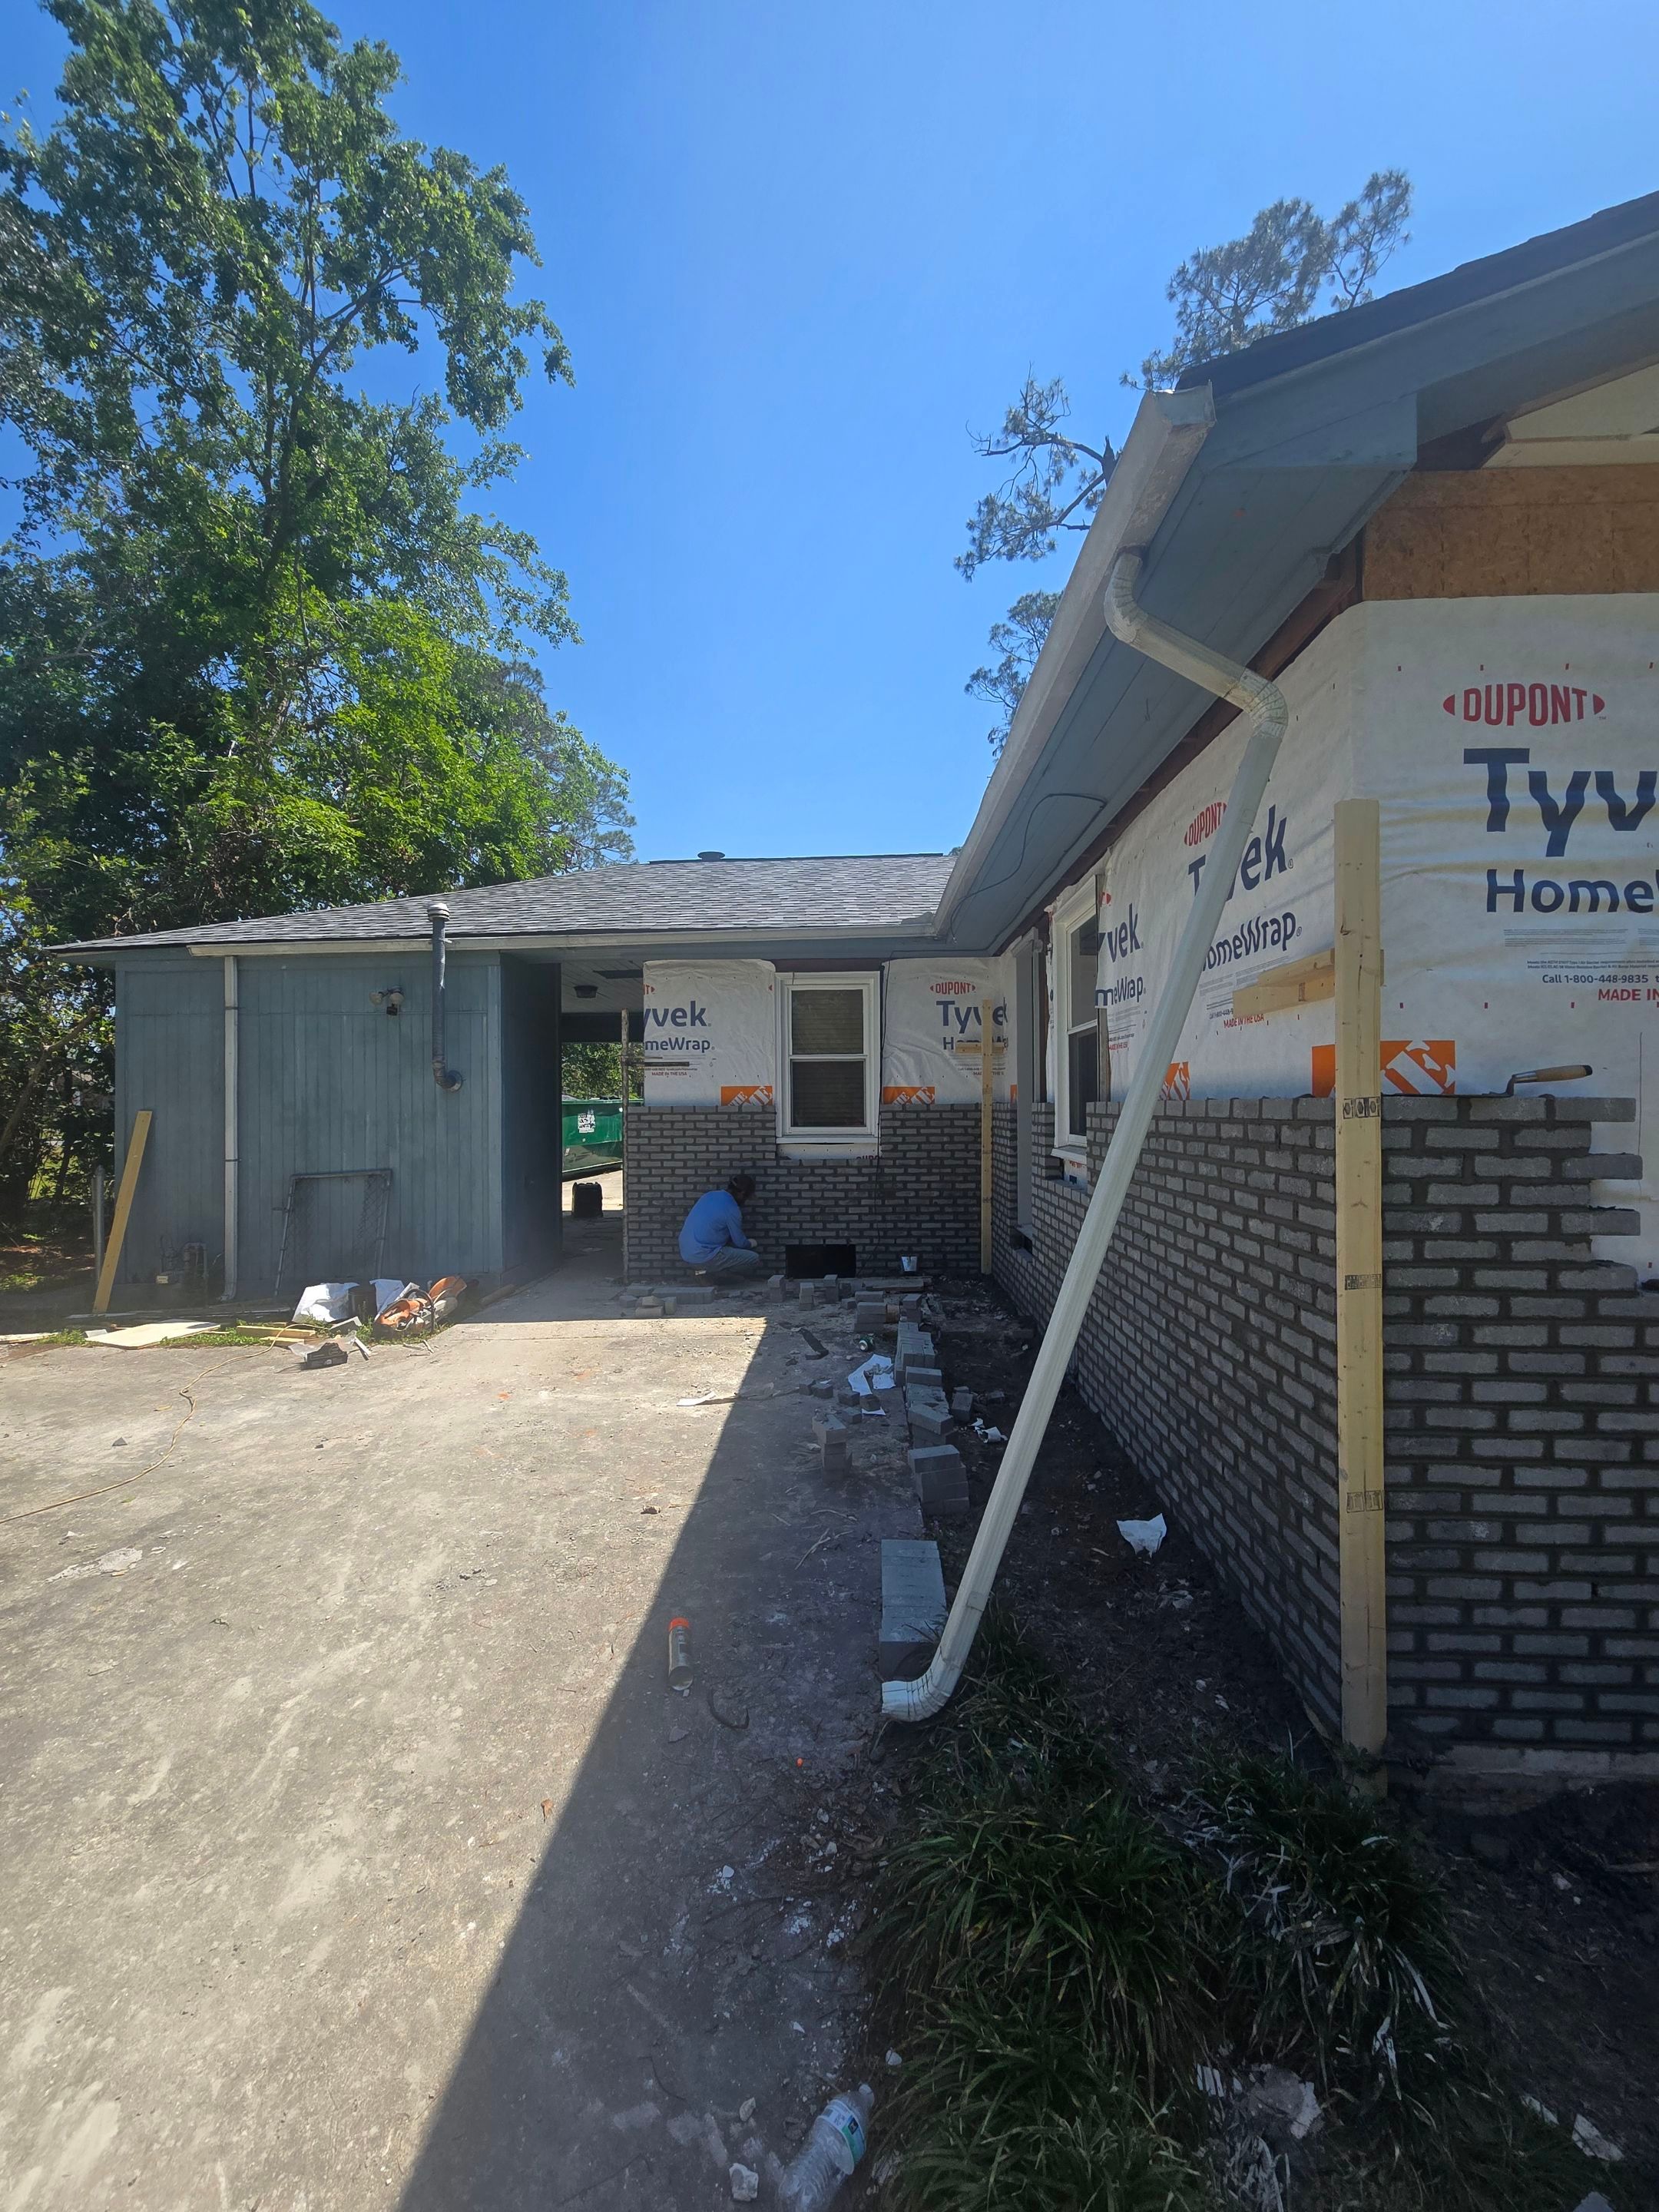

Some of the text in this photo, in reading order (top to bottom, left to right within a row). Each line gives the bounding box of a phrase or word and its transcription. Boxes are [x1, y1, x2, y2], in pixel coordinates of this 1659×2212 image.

[1464, 683, 1587, 726] DUPONT
[1188, 802, 1222, 846] DUPONT
[1188, 804, 1287, 902] Tek
[1487, 869, 1659, 913] Home
[1203, 912, 1296, 972] omeWrap
[935, 982, 972, 995] DUPONT
[1542, 975, 1562, 984] Call
[1565, 975, 1648, 984] 1-800-448-9835
[1598, 988, 1641, 1001] MADE
[645, 1037, 710, 1053] meWrap
